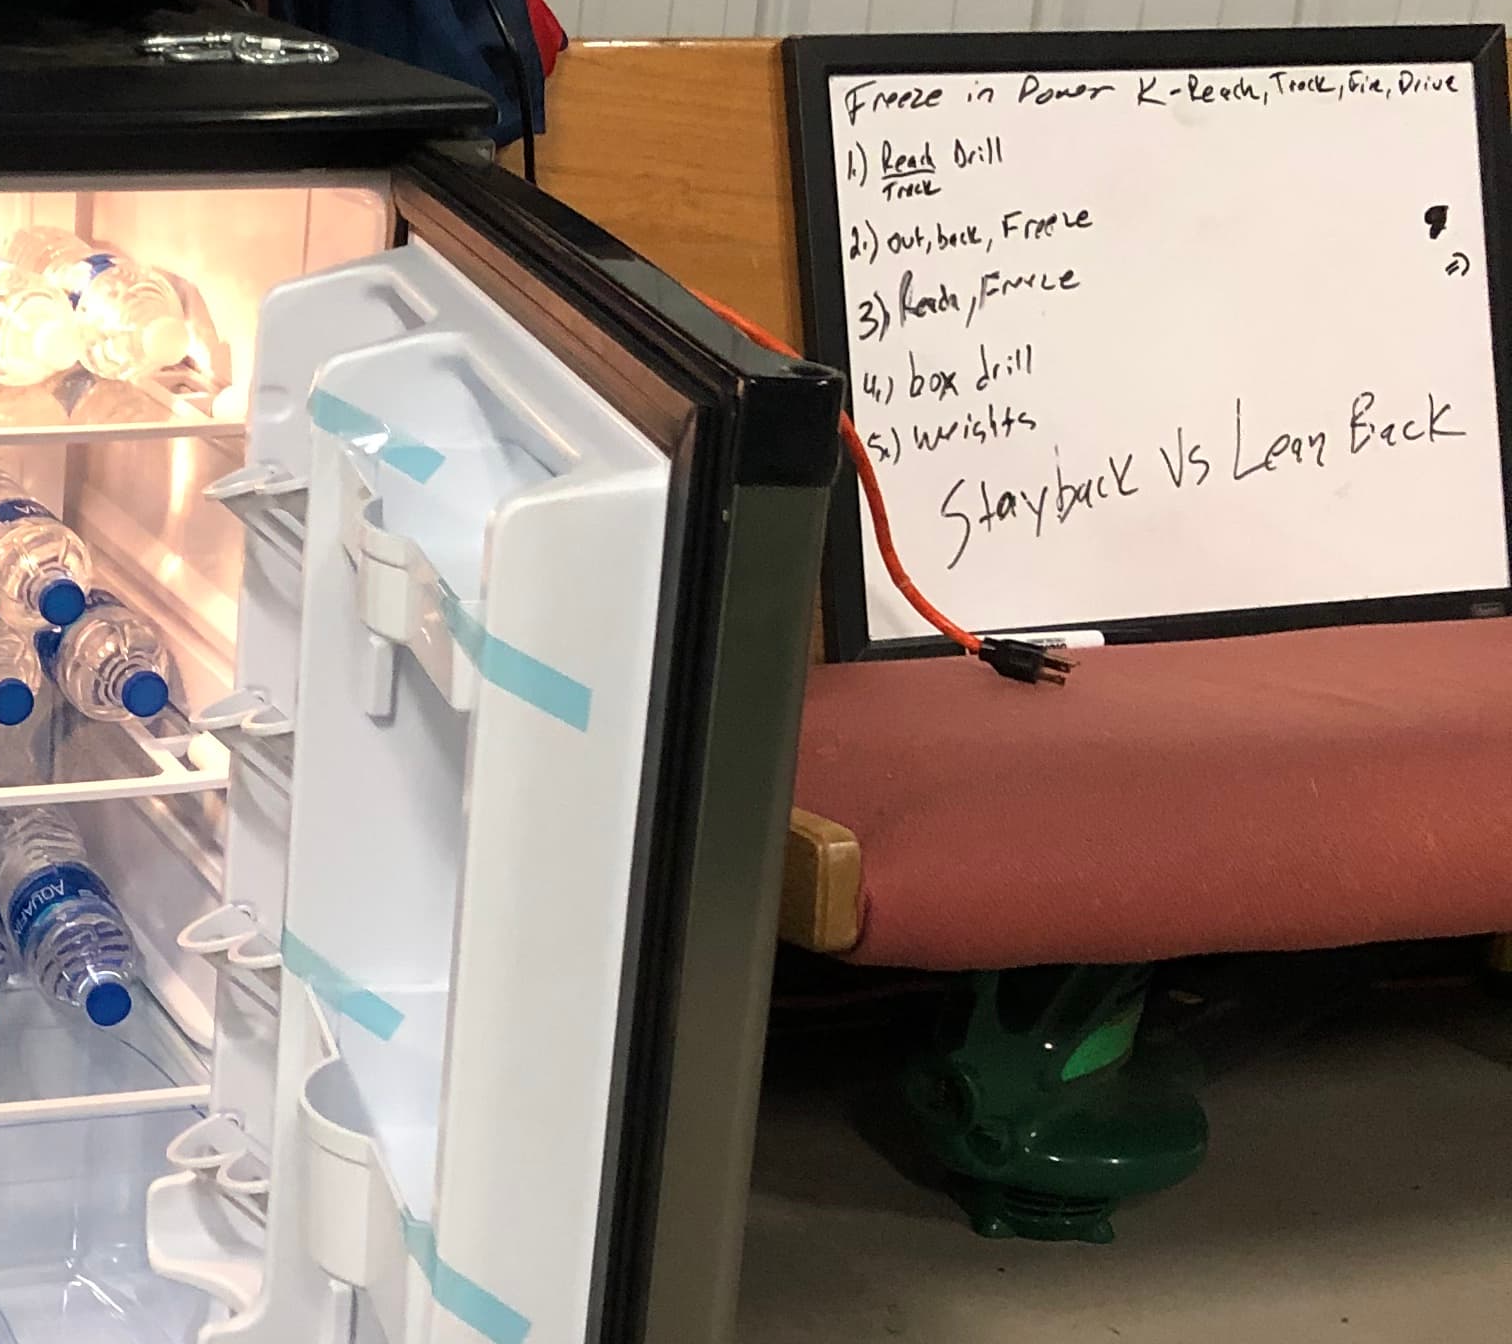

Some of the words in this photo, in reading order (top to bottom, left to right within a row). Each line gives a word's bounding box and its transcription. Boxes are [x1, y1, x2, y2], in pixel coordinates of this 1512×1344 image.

[844, 79, 944, 126] Freeze
[966, 79, 995, 104] in
[1398, 69, 1459, 96] Drive
[953, 135, 1003, 168] Drill
[908, 349, 960, 402] box
[975, 343, 1033, 391] drill
[1233, 397, 1328, 480] Lean
[1349, 391, 1467, 455] Back
